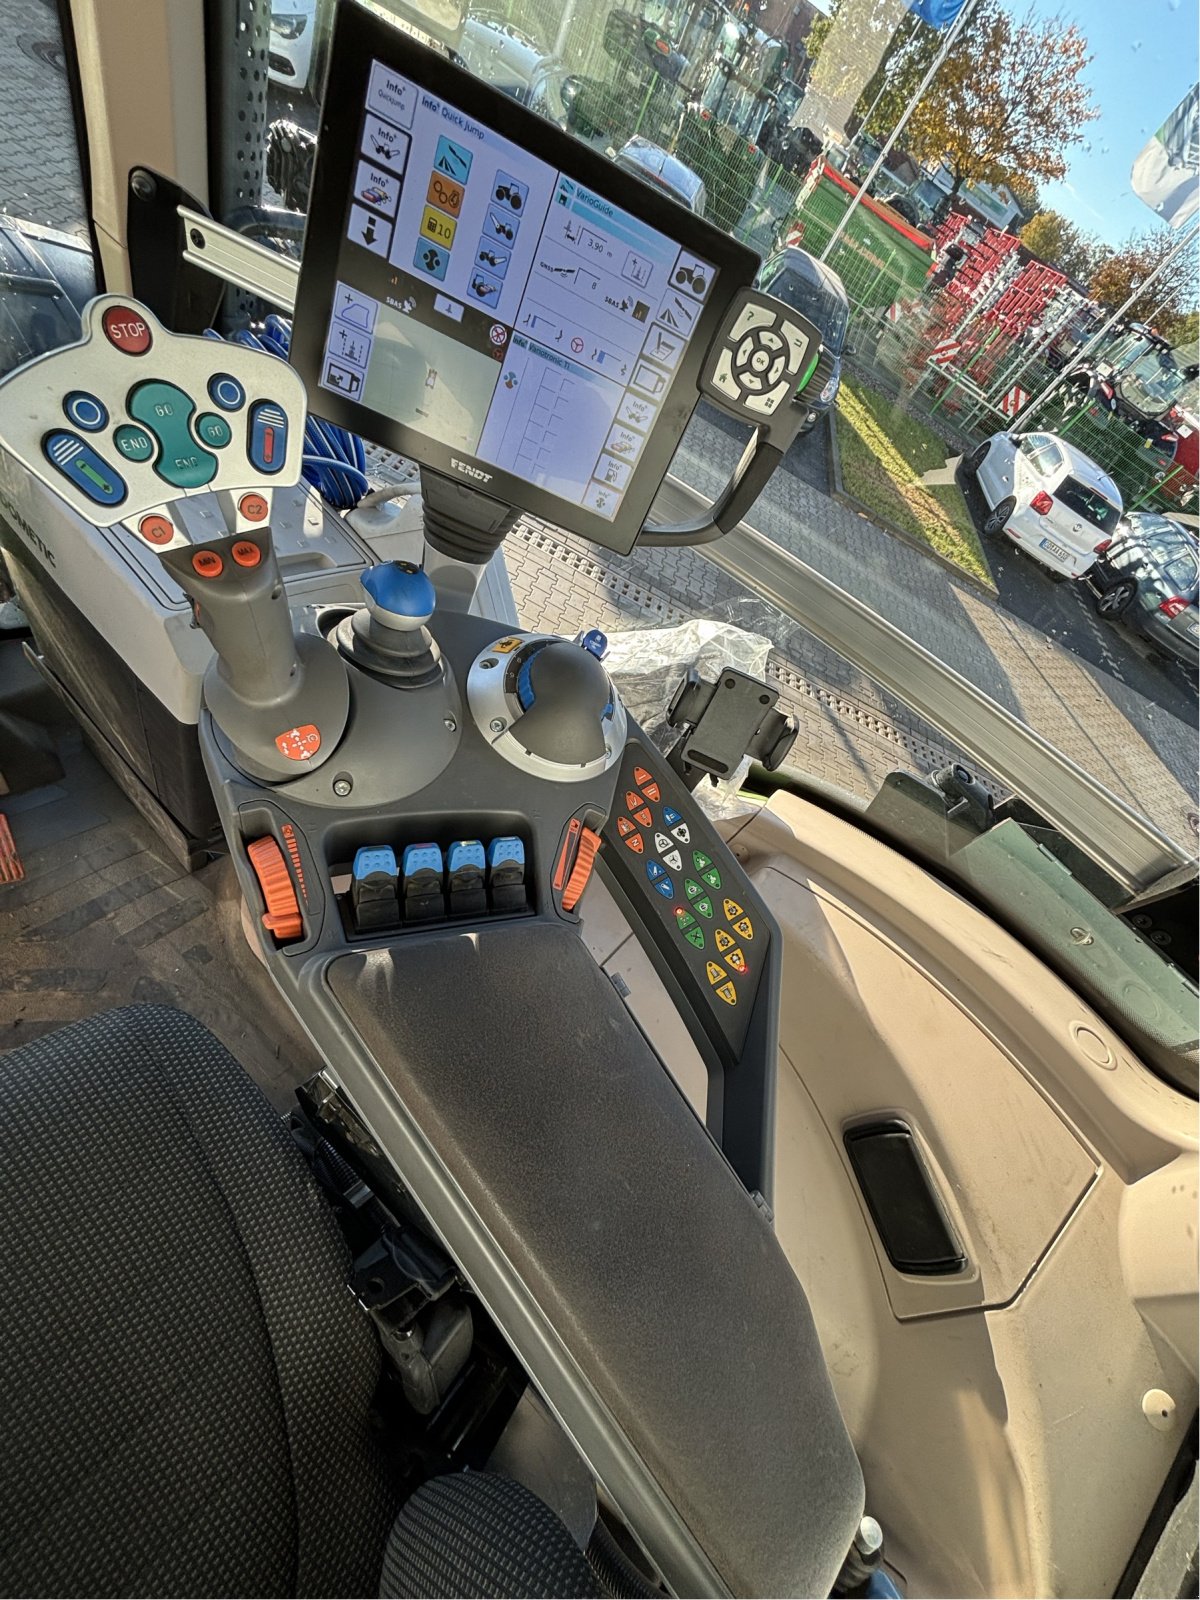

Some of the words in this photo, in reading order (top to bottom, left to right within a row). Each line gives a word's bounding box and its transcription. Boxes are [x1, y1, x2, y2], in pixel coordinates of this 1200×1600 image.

[441, 107, 463, 128] Quick
[576, 188, 614, 217] VarioGuide
[437, 224, 451, 239] 10
[605, 296, 620, 308] SBAS
[110, 322, 145, 339] STOP
[756, 357, 766, 366] OK
[155, 404, 174, 417] GO
[208, 425, 223, 438] GO
[120, 436, 148, 453] END
[175, 456, 199, 470] END
[451, 457, 493, 483] FENDT
[247, 503, 263, 515] C2
[151, 526, 165, 539] C1
